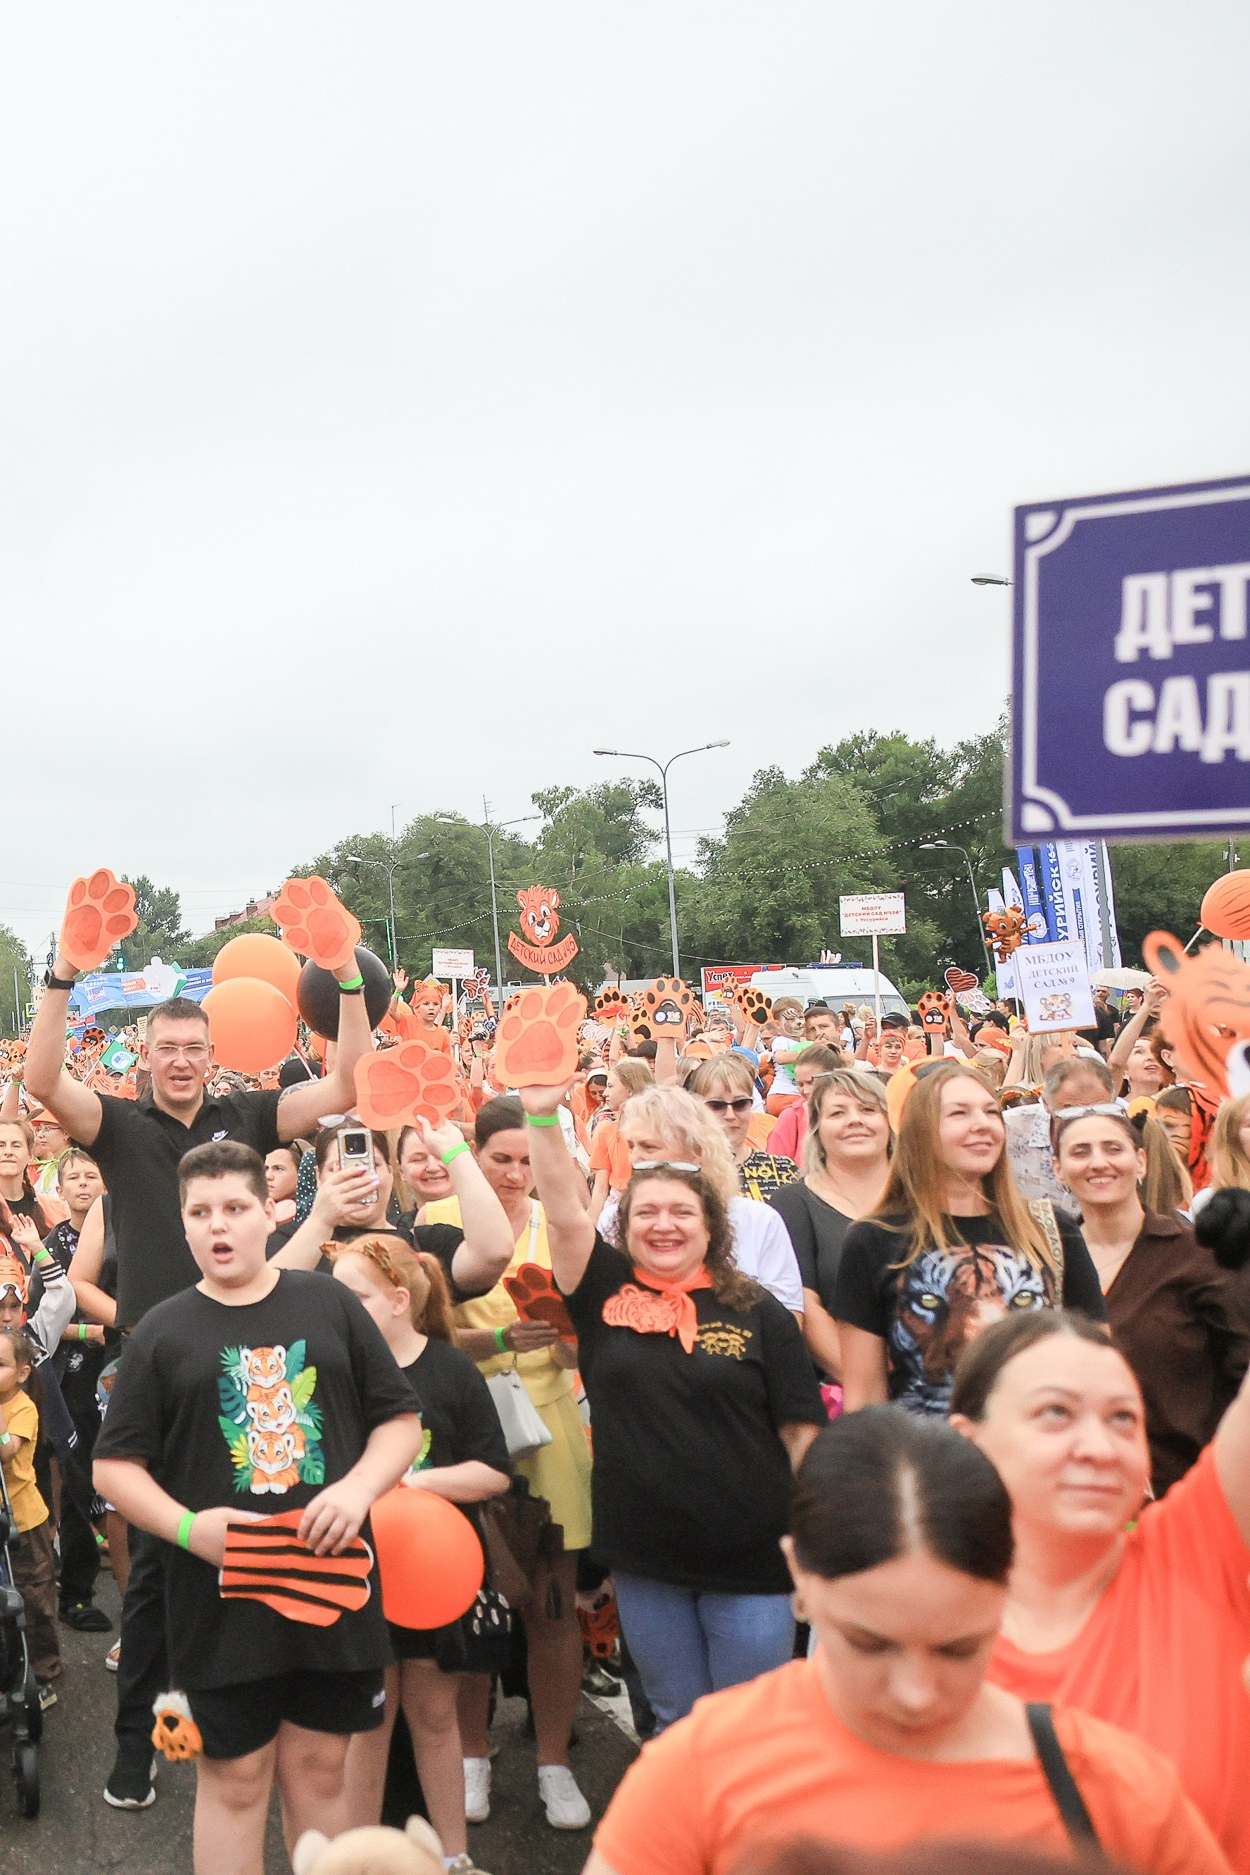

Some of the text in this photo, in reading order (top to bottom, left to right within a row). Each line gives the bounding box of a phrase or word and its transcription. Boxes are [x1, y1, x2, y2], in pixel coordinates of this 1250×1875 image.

[1049, 866, 1069, 942] УРИЙСК
[1025, 950, 1074, 965] МБДОУ
[1029, 965, 1079, 979] ДЕТСКИЙ
[1033, 979, 1056, 989] САД
